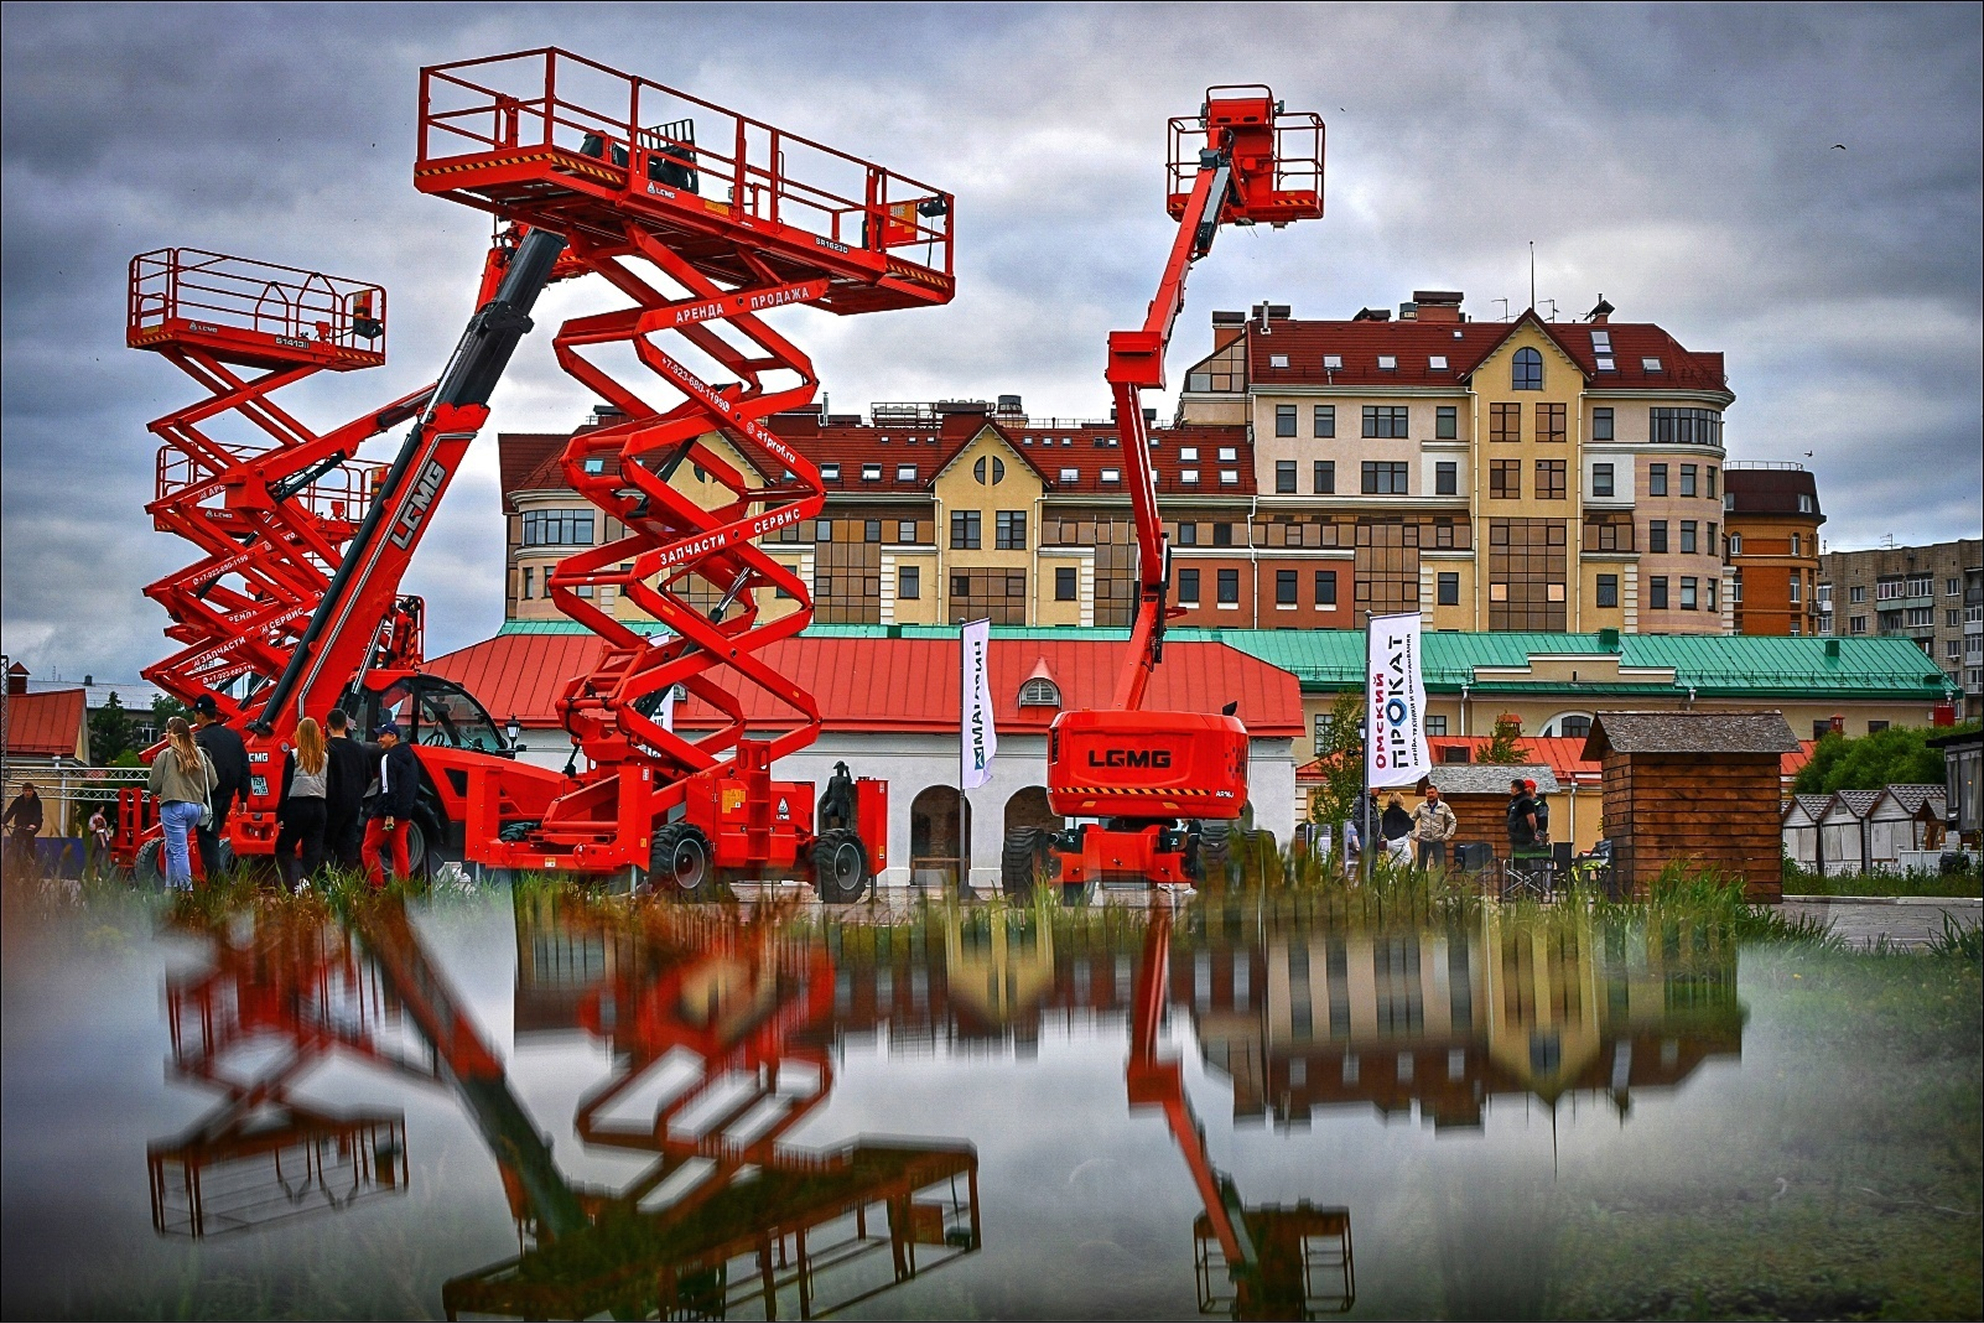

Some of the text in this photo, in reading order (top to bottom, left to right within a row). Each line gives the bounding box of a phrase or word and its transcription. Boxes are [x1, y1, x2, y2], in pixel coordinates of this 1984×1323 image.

[676, 287, 810, 323] АРЕНДА ПРОДАЖА
[757, 430, 796, 464] a1prof.ru
[390, 460, 446, 550] LGMG
[660, 508, 801, 566] ЗАПЧАСТИ СЕРВИС
[201, 636, 247, 665] ЗАПЧАСТИ
[269, 607, 305, 630] СЕРВИС
[1372, 673, 1387, 769] ОМСКИЙ
[1386, 635, 1409, 769] ПРОКАТ
[1088, 750, 1171, 768] LGMG
